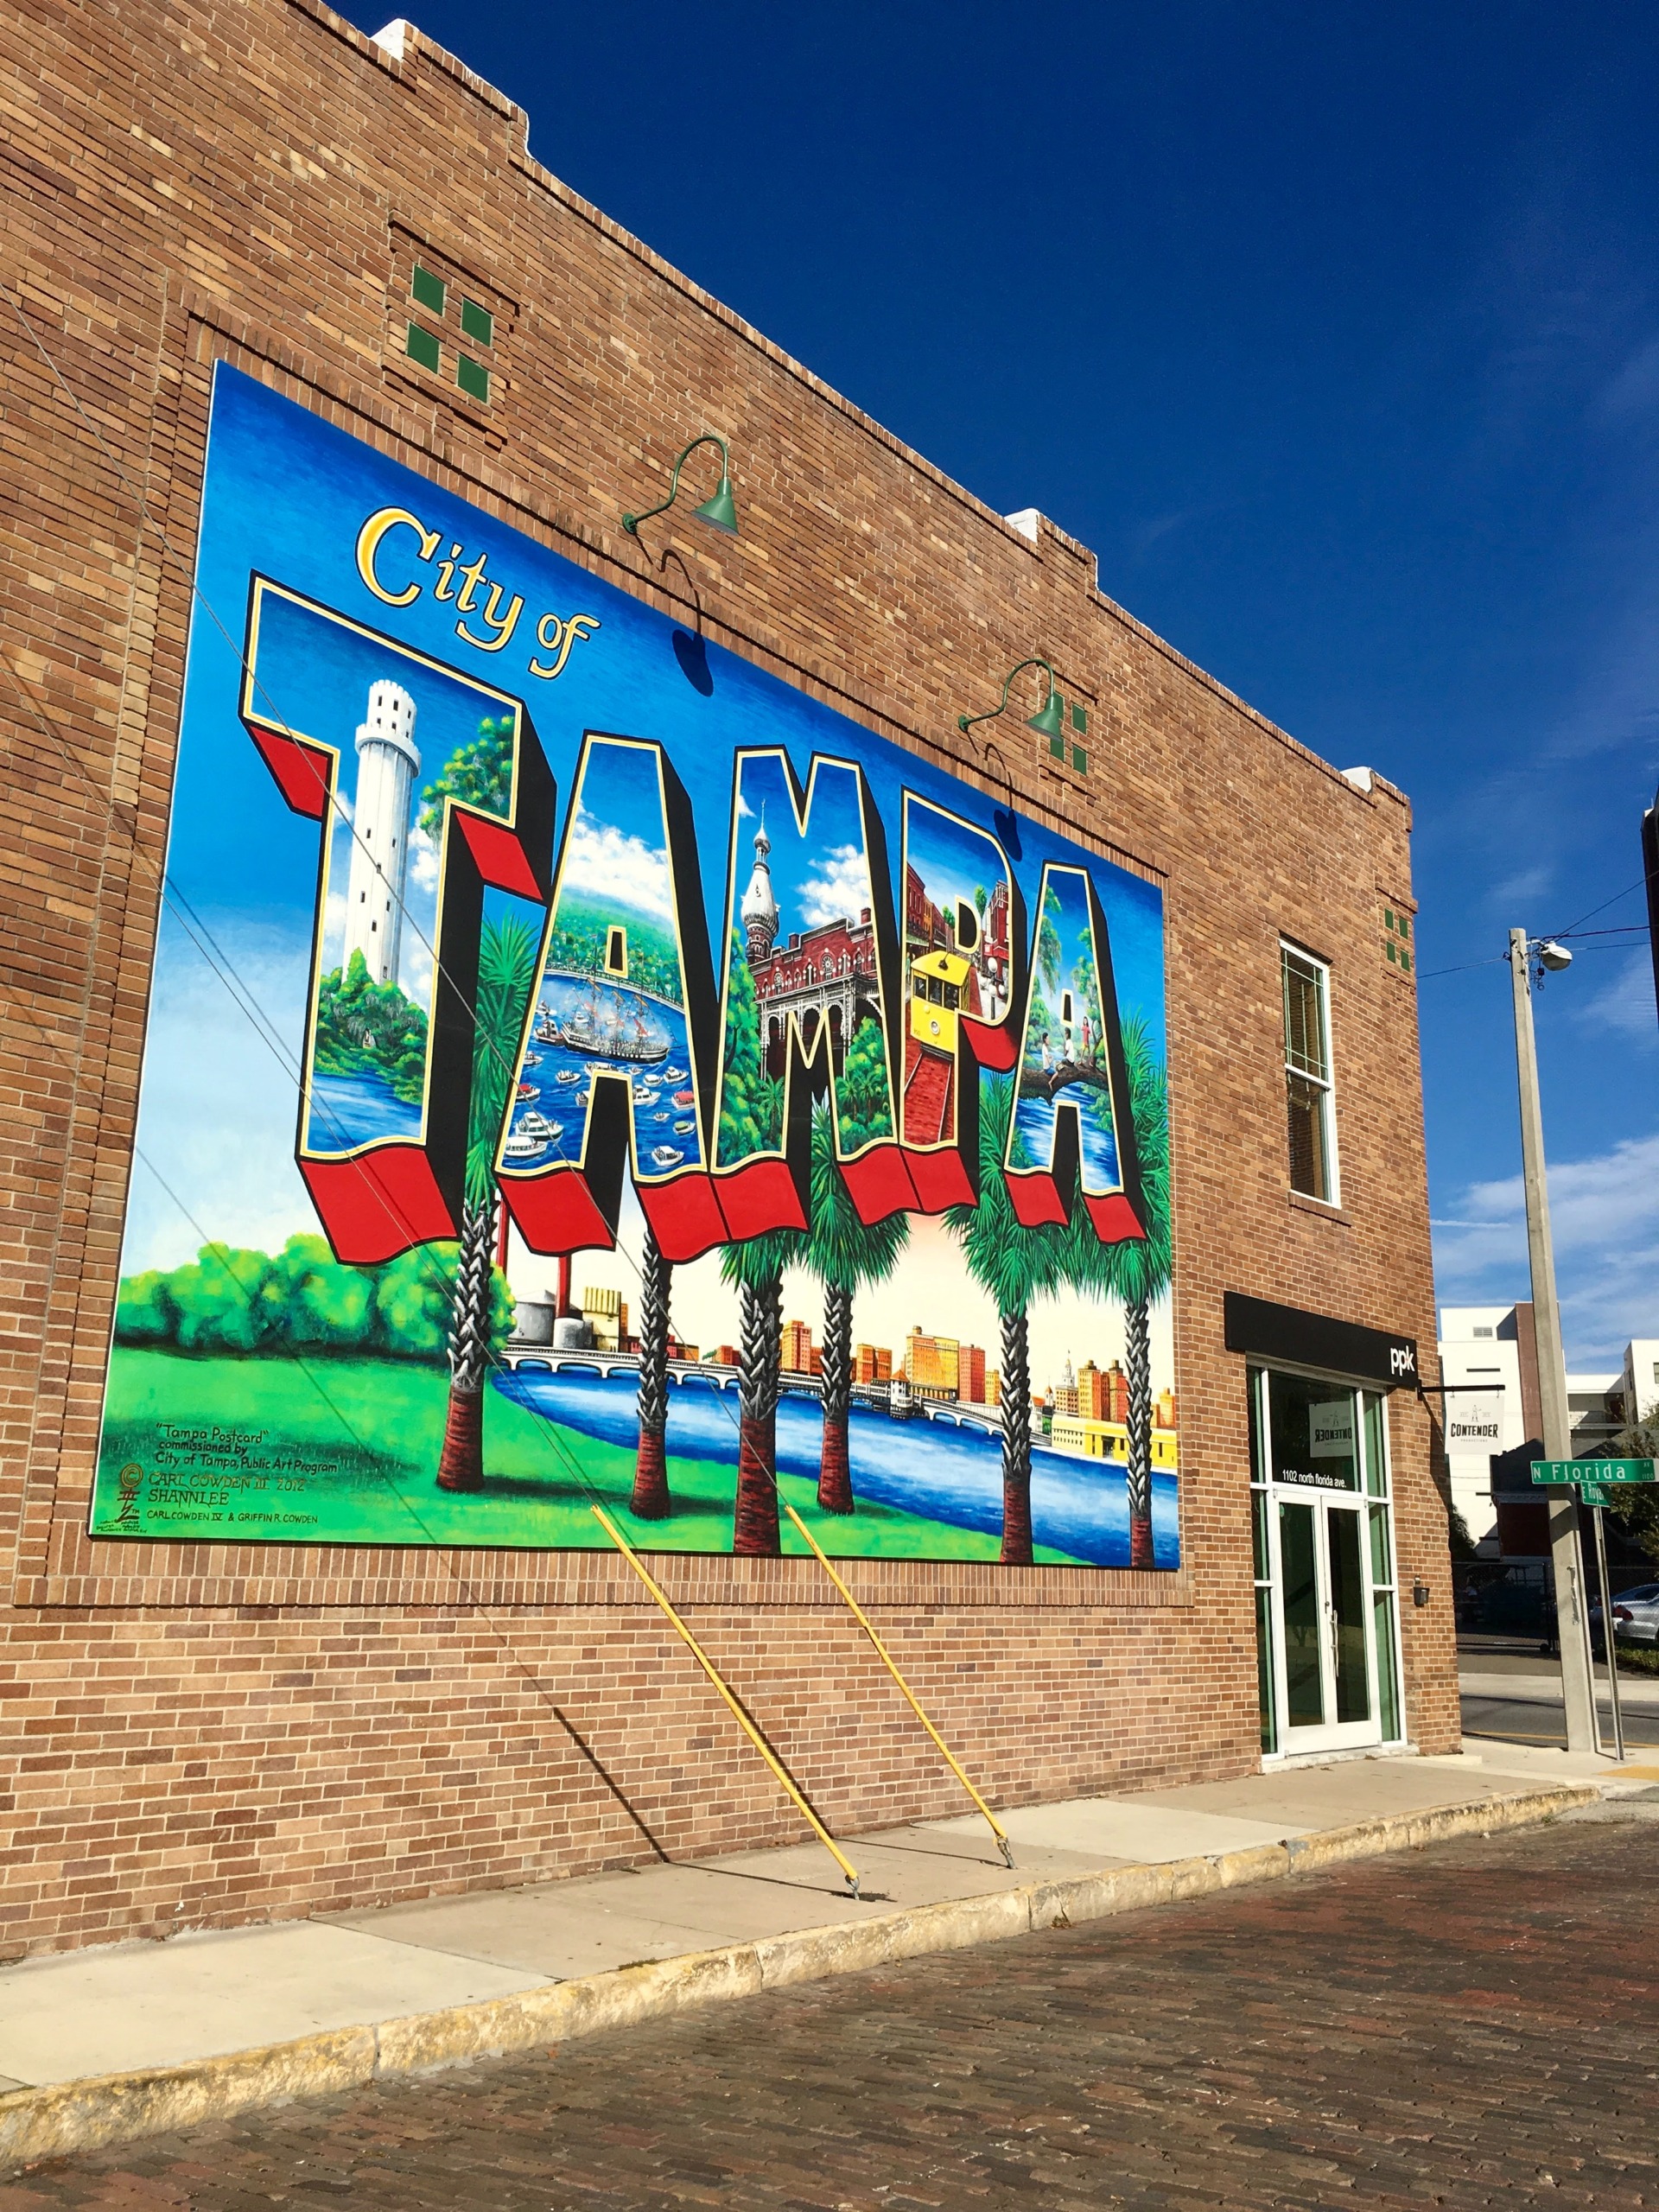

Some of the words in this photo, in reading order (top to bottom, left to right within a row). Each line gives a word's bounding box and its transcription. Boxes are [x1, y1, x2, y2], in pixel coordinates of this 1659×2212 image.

[354, 505, 525, 653] City
[527, 613, 602, 680] of
[238, 569, 1147, 1265] TAMPA
[1390, 1344, 1415, 1376] ppk
[1451, 1422, 1498, 1439] CONTENDER
[159, 1440, 231, 1453] commissioned
[235, 1442, 248, 1457] by
[156, 1452, 181, 1469] City
[183, 1452, 196, 1465] of
[200, 1453, 239, 1471] Tampa,
[240, 1456, 270, 1470] Public
[274, 1457, 292, 1471] Art
[294, 1459, 338, 1476] Program
[1533, 1466, 1541, 1479] N
[1552, 1463, 1626, 1481] Florida
[149, 1472, 190, 1490] CARL
[189, 1474, 251, 1494] COWDEN
[276, 1478, 307, 1492] 2012
[1282, 1469, 1297, 1482] 1102
[1298, 1472, 1314, 1484] north
[1315, 1473, 1333, 1486] florida
[1334, 1478, 1347, 1488] ave.
[147, 1510, 170, 1520] CARL
[172, 1511, 209, 1521] COWDEN
[212, 1512, 224, 1522] IV
[228, 1512, 234, 1522] &
[238, 1513, 272, 1522] GRIFFIN
[283, 1514, 318, 1524] COWDEN
